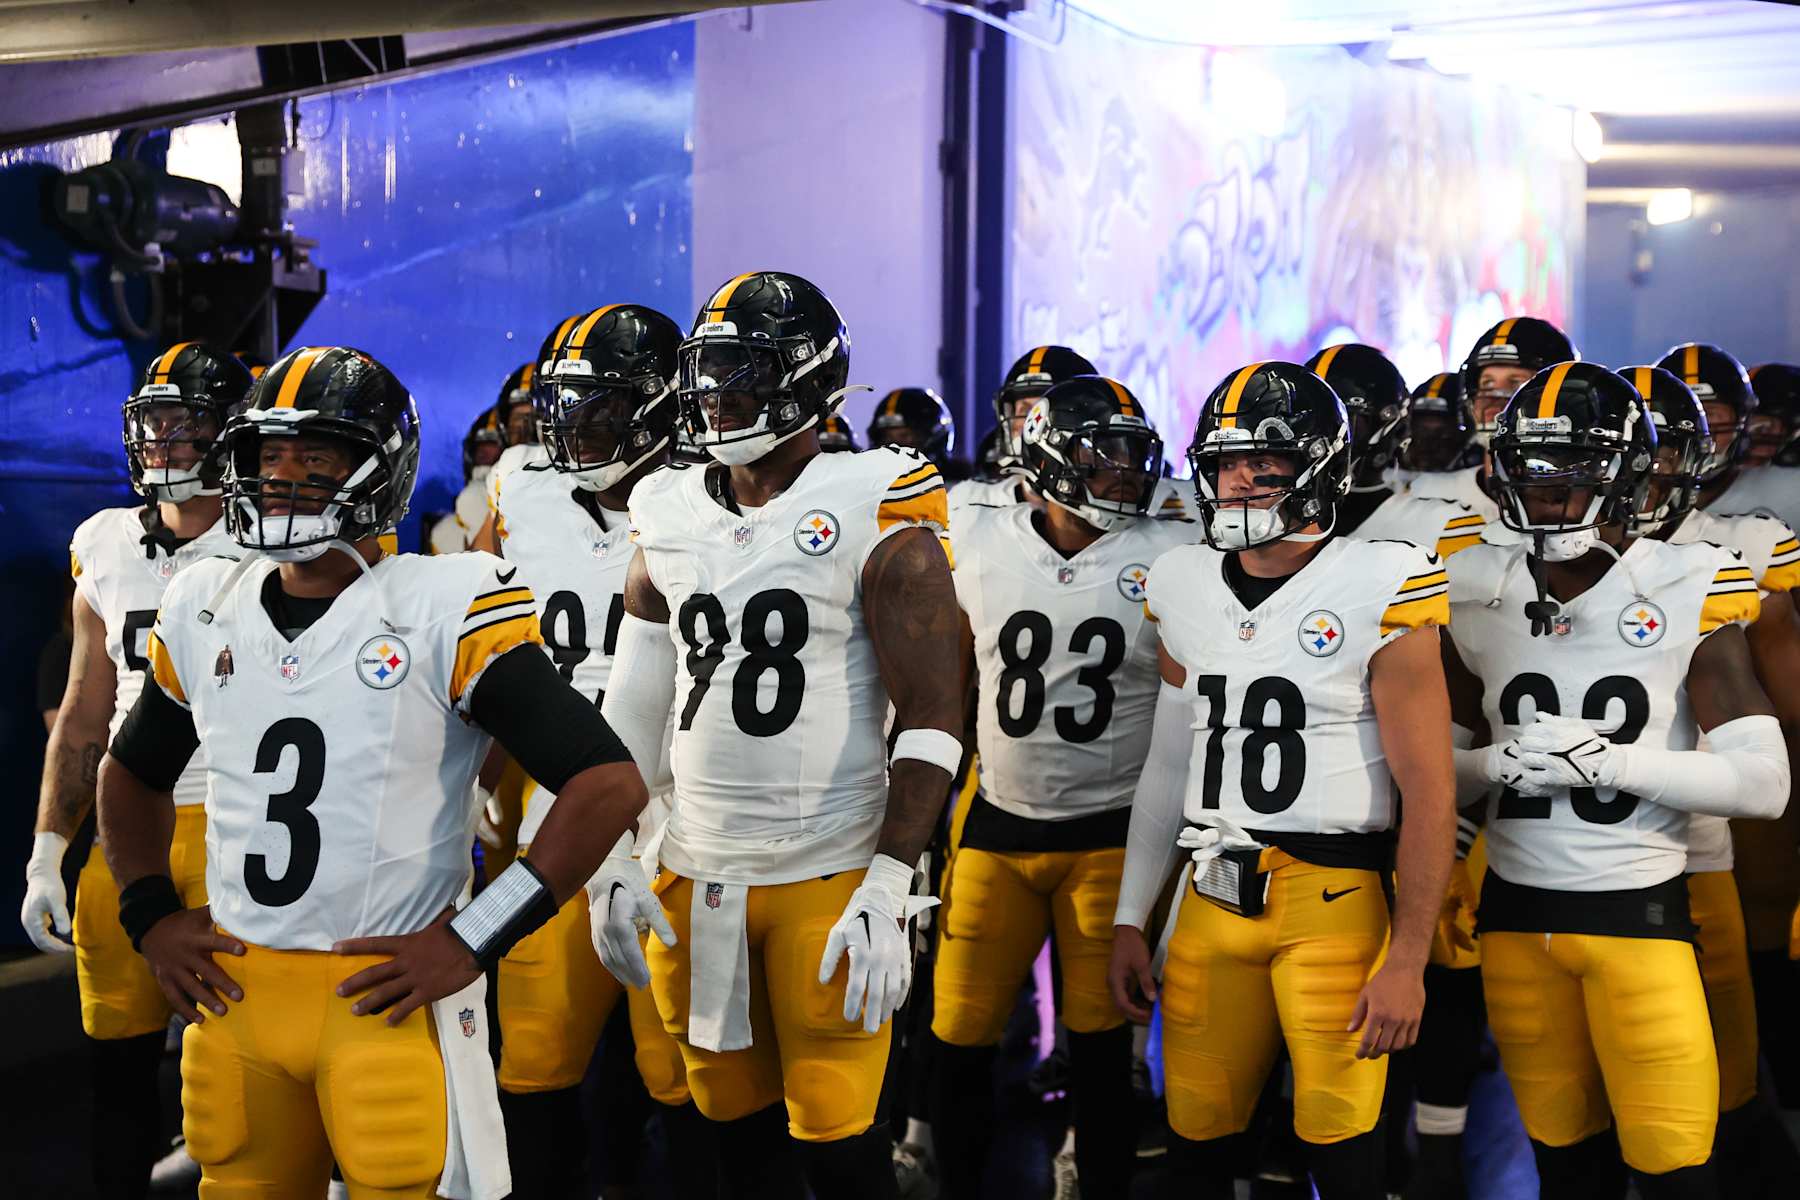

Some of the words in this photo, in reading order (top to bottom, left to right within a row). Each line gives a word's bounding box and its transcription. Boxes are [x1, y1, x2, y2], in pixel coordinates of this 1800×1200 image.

[540, 591, 625, 710] 9
[679, 588, 809, 737] 98
[996, 610, 1127, 744] 83
[243, 716, 326, 908] 3
[1197, 674, 1306, 815] 18
[1496, 672, 1650, 825] 23
